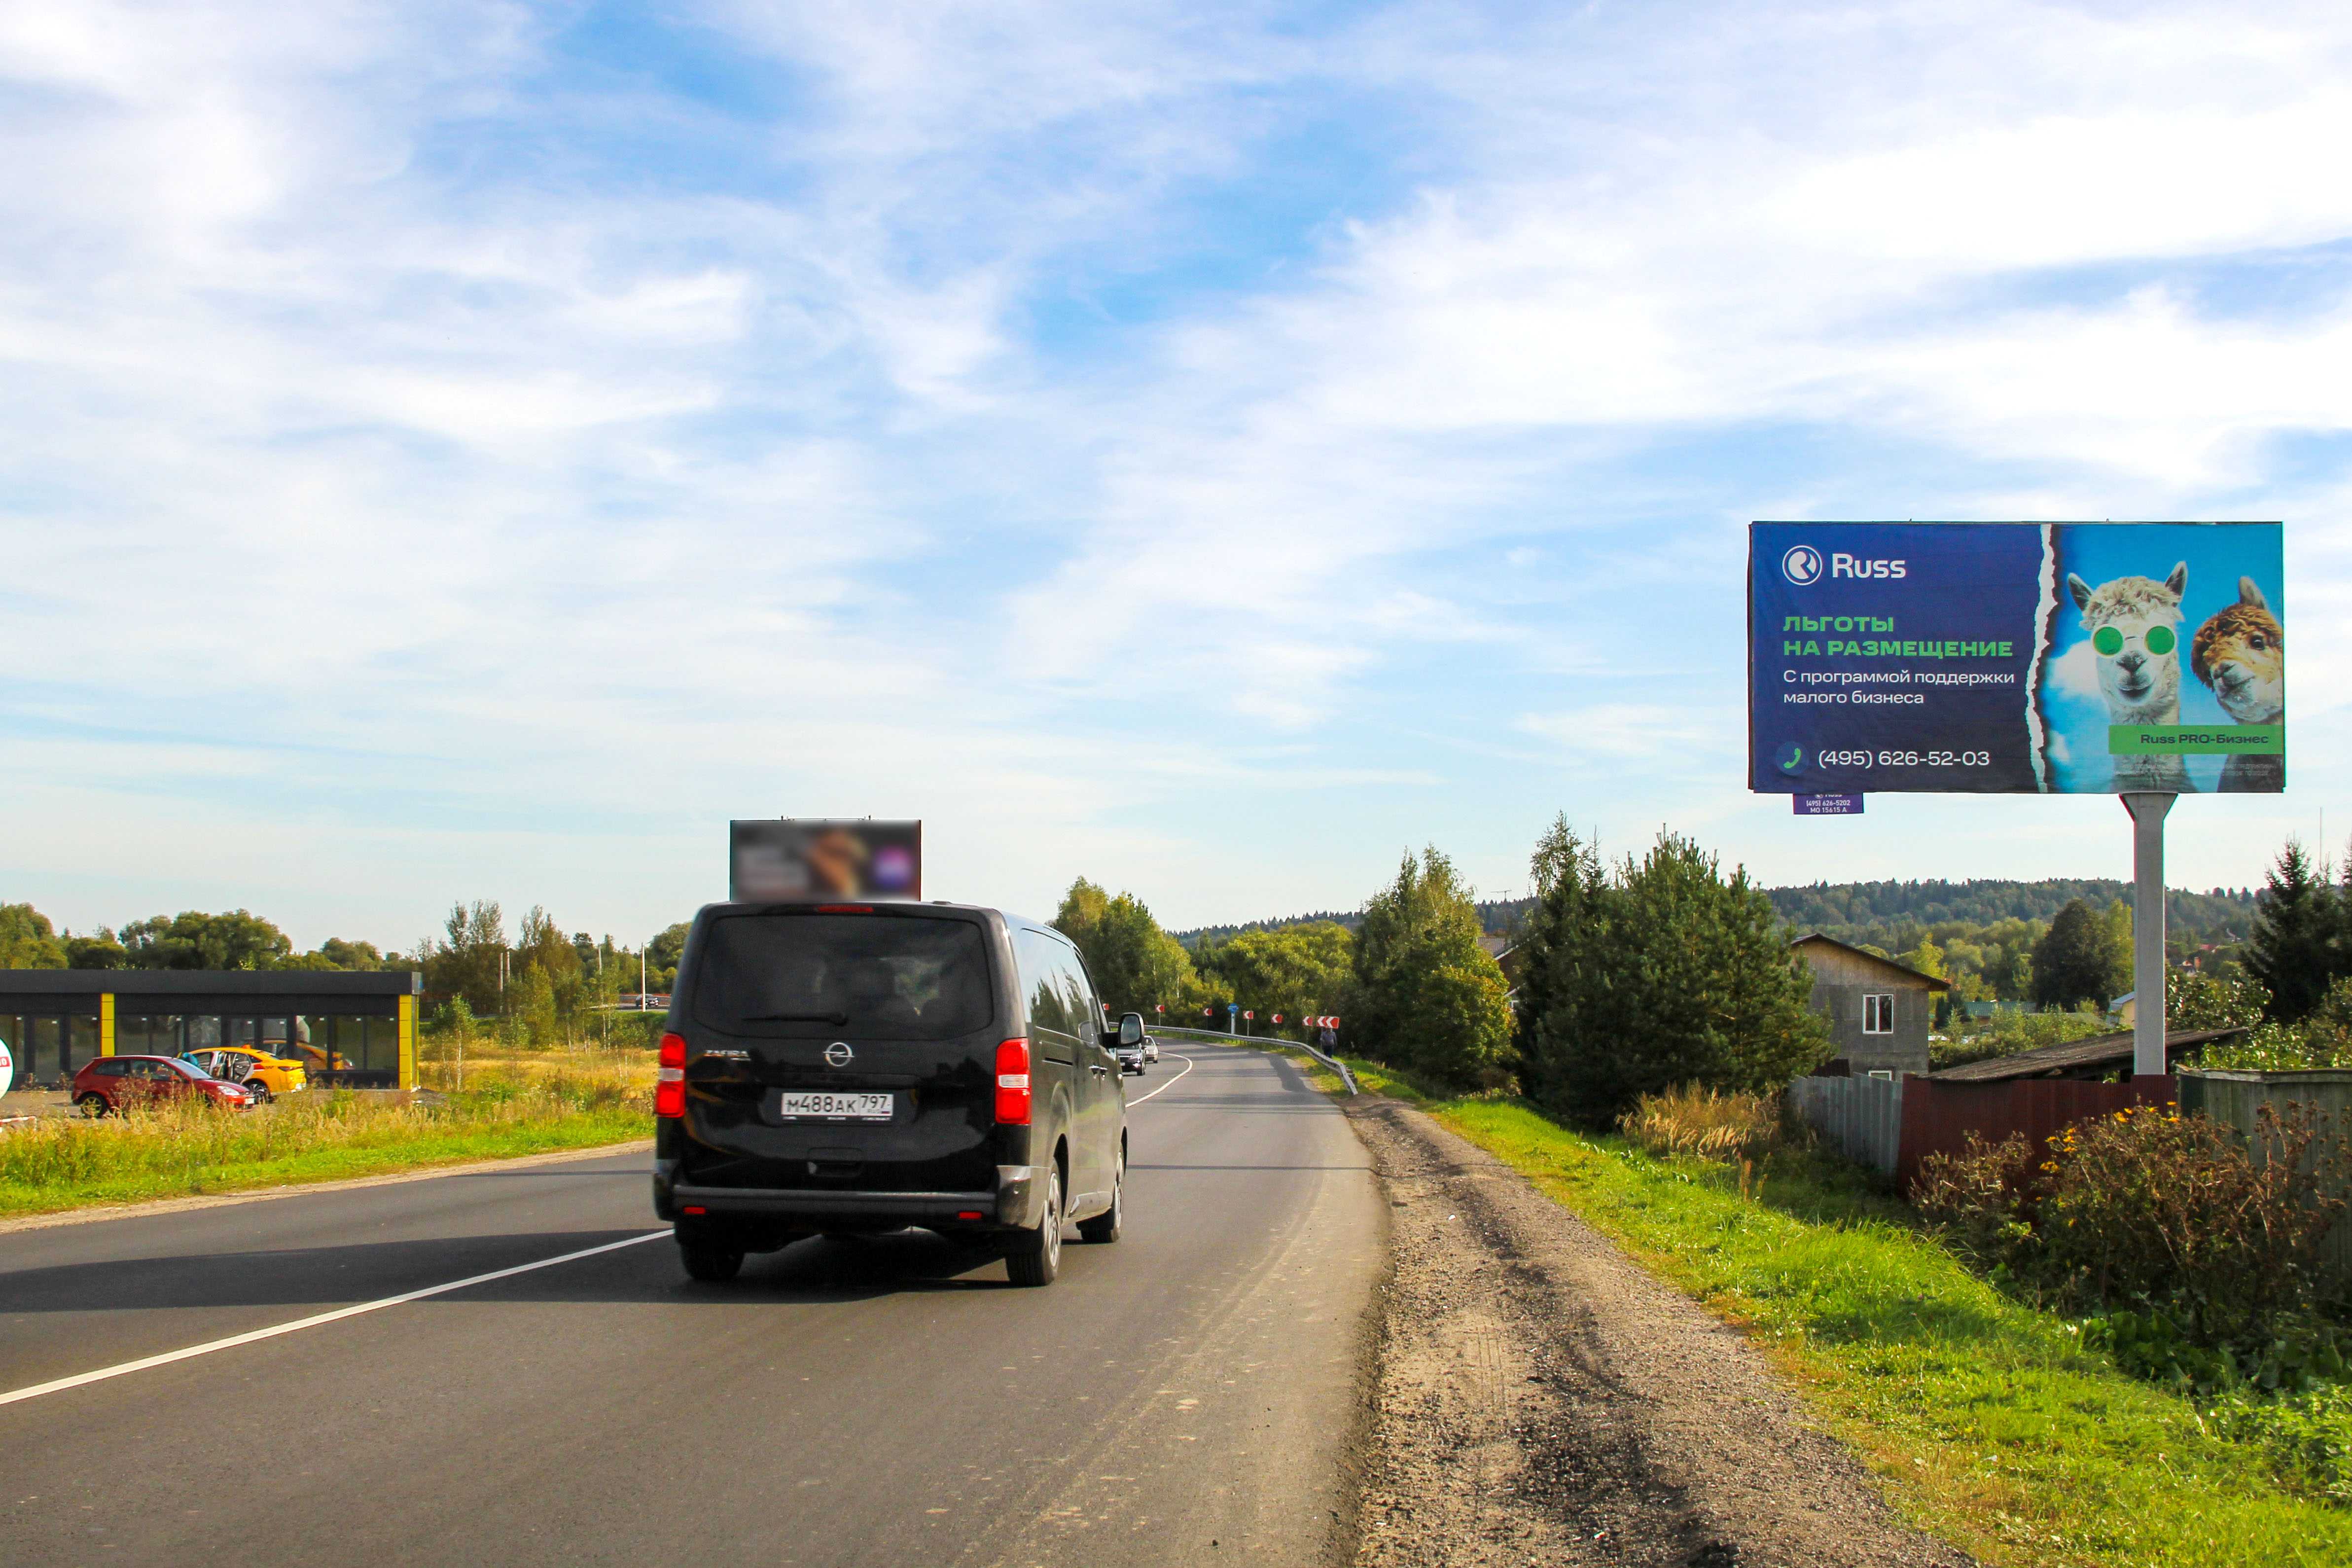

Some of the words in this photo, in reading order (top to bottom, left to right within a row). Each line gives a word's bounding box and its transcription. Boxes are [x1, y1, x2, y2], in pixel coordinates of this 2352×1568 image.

[1832, 553, 1906, 578] Russ
[1782, 616, 1894, 632] ЛЬГОТЫ
[1783, 641, 1821, 656] НА
[1827, 641, 2013, 659] РАЗМЕЩЕНИЕ
[1783, 670, 1797, 683] С
[1801, 669, 1911, 685] программой
[1914, 673, 2015, 686] поддержки
[1783, 693, 1848, 704] малого
[1852, 690, 1924, 704] бизнеса
[2140, 734, 2175, 744] Russ
[2178, 734, 2269, 745] PRO-Бизнес
[1818, 750, 1873, 769] (495)
[1878, 750, 1990, 766] 626-52-03
[859, 1095, 888, 1108] 797
